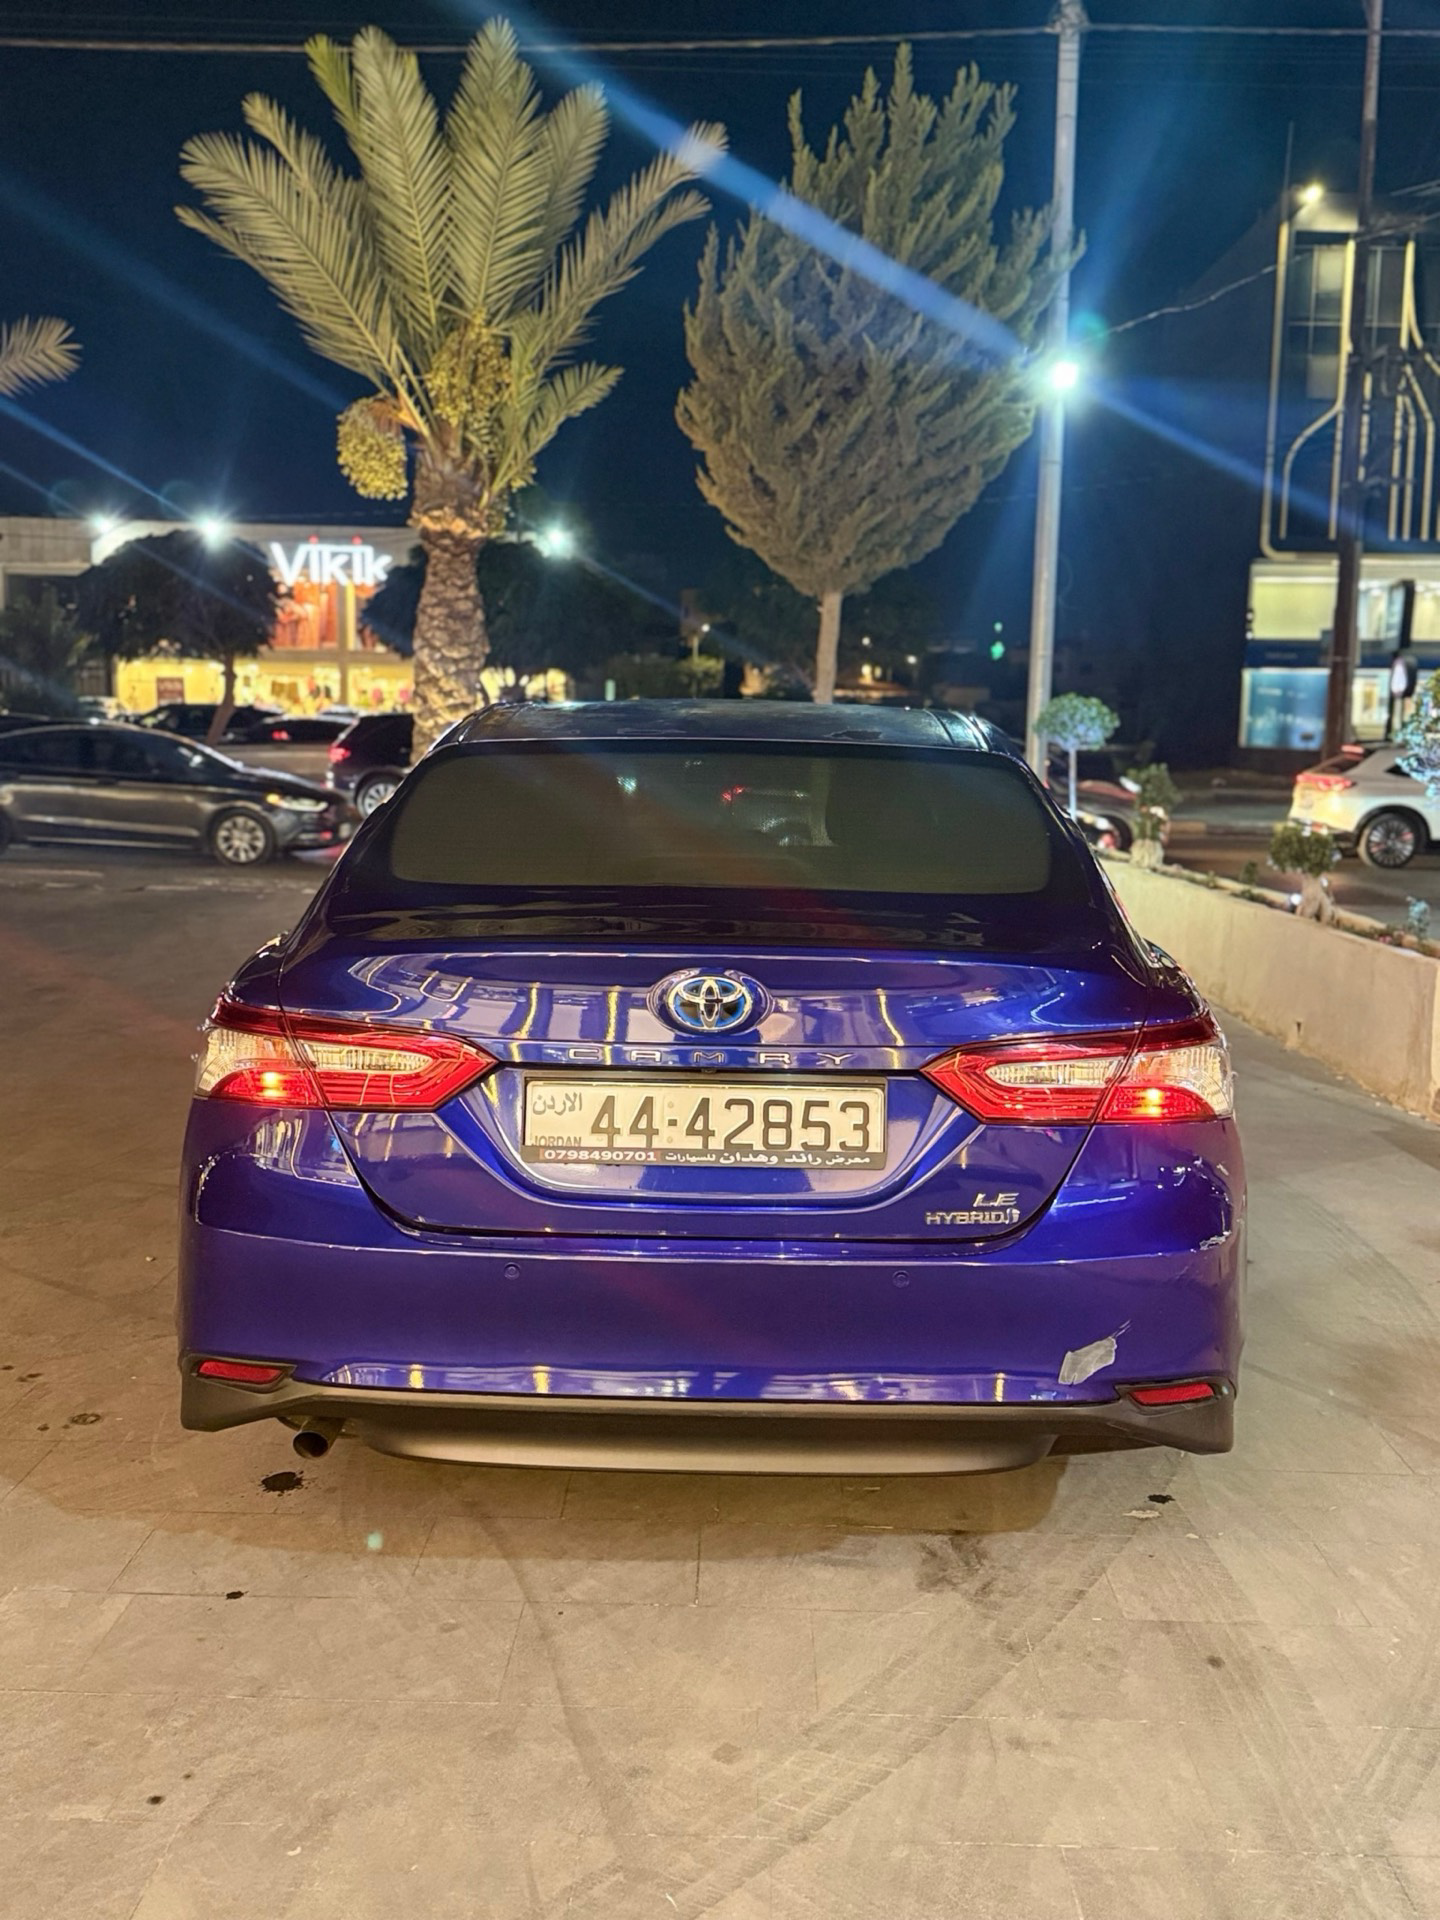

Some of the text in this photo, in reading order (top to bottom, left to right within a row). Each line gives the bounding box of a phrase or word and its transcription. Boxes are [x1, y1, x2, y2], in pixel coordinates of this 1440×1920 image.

[568, 1047, 856, 1066] CAMRY
[590, 1094, 870, 1153] 44-42853
[532, 1134, 582, 1148] JORDAN
[544, 1149, 657, 1162] 0798490701
[665, 1152, 716, 1163] للسيارات
[825, 1156, 871, 1166] معرض
[973, 1192, 1020, 1207] LE
[925, 1210, 1004, 1225] HYBRID
